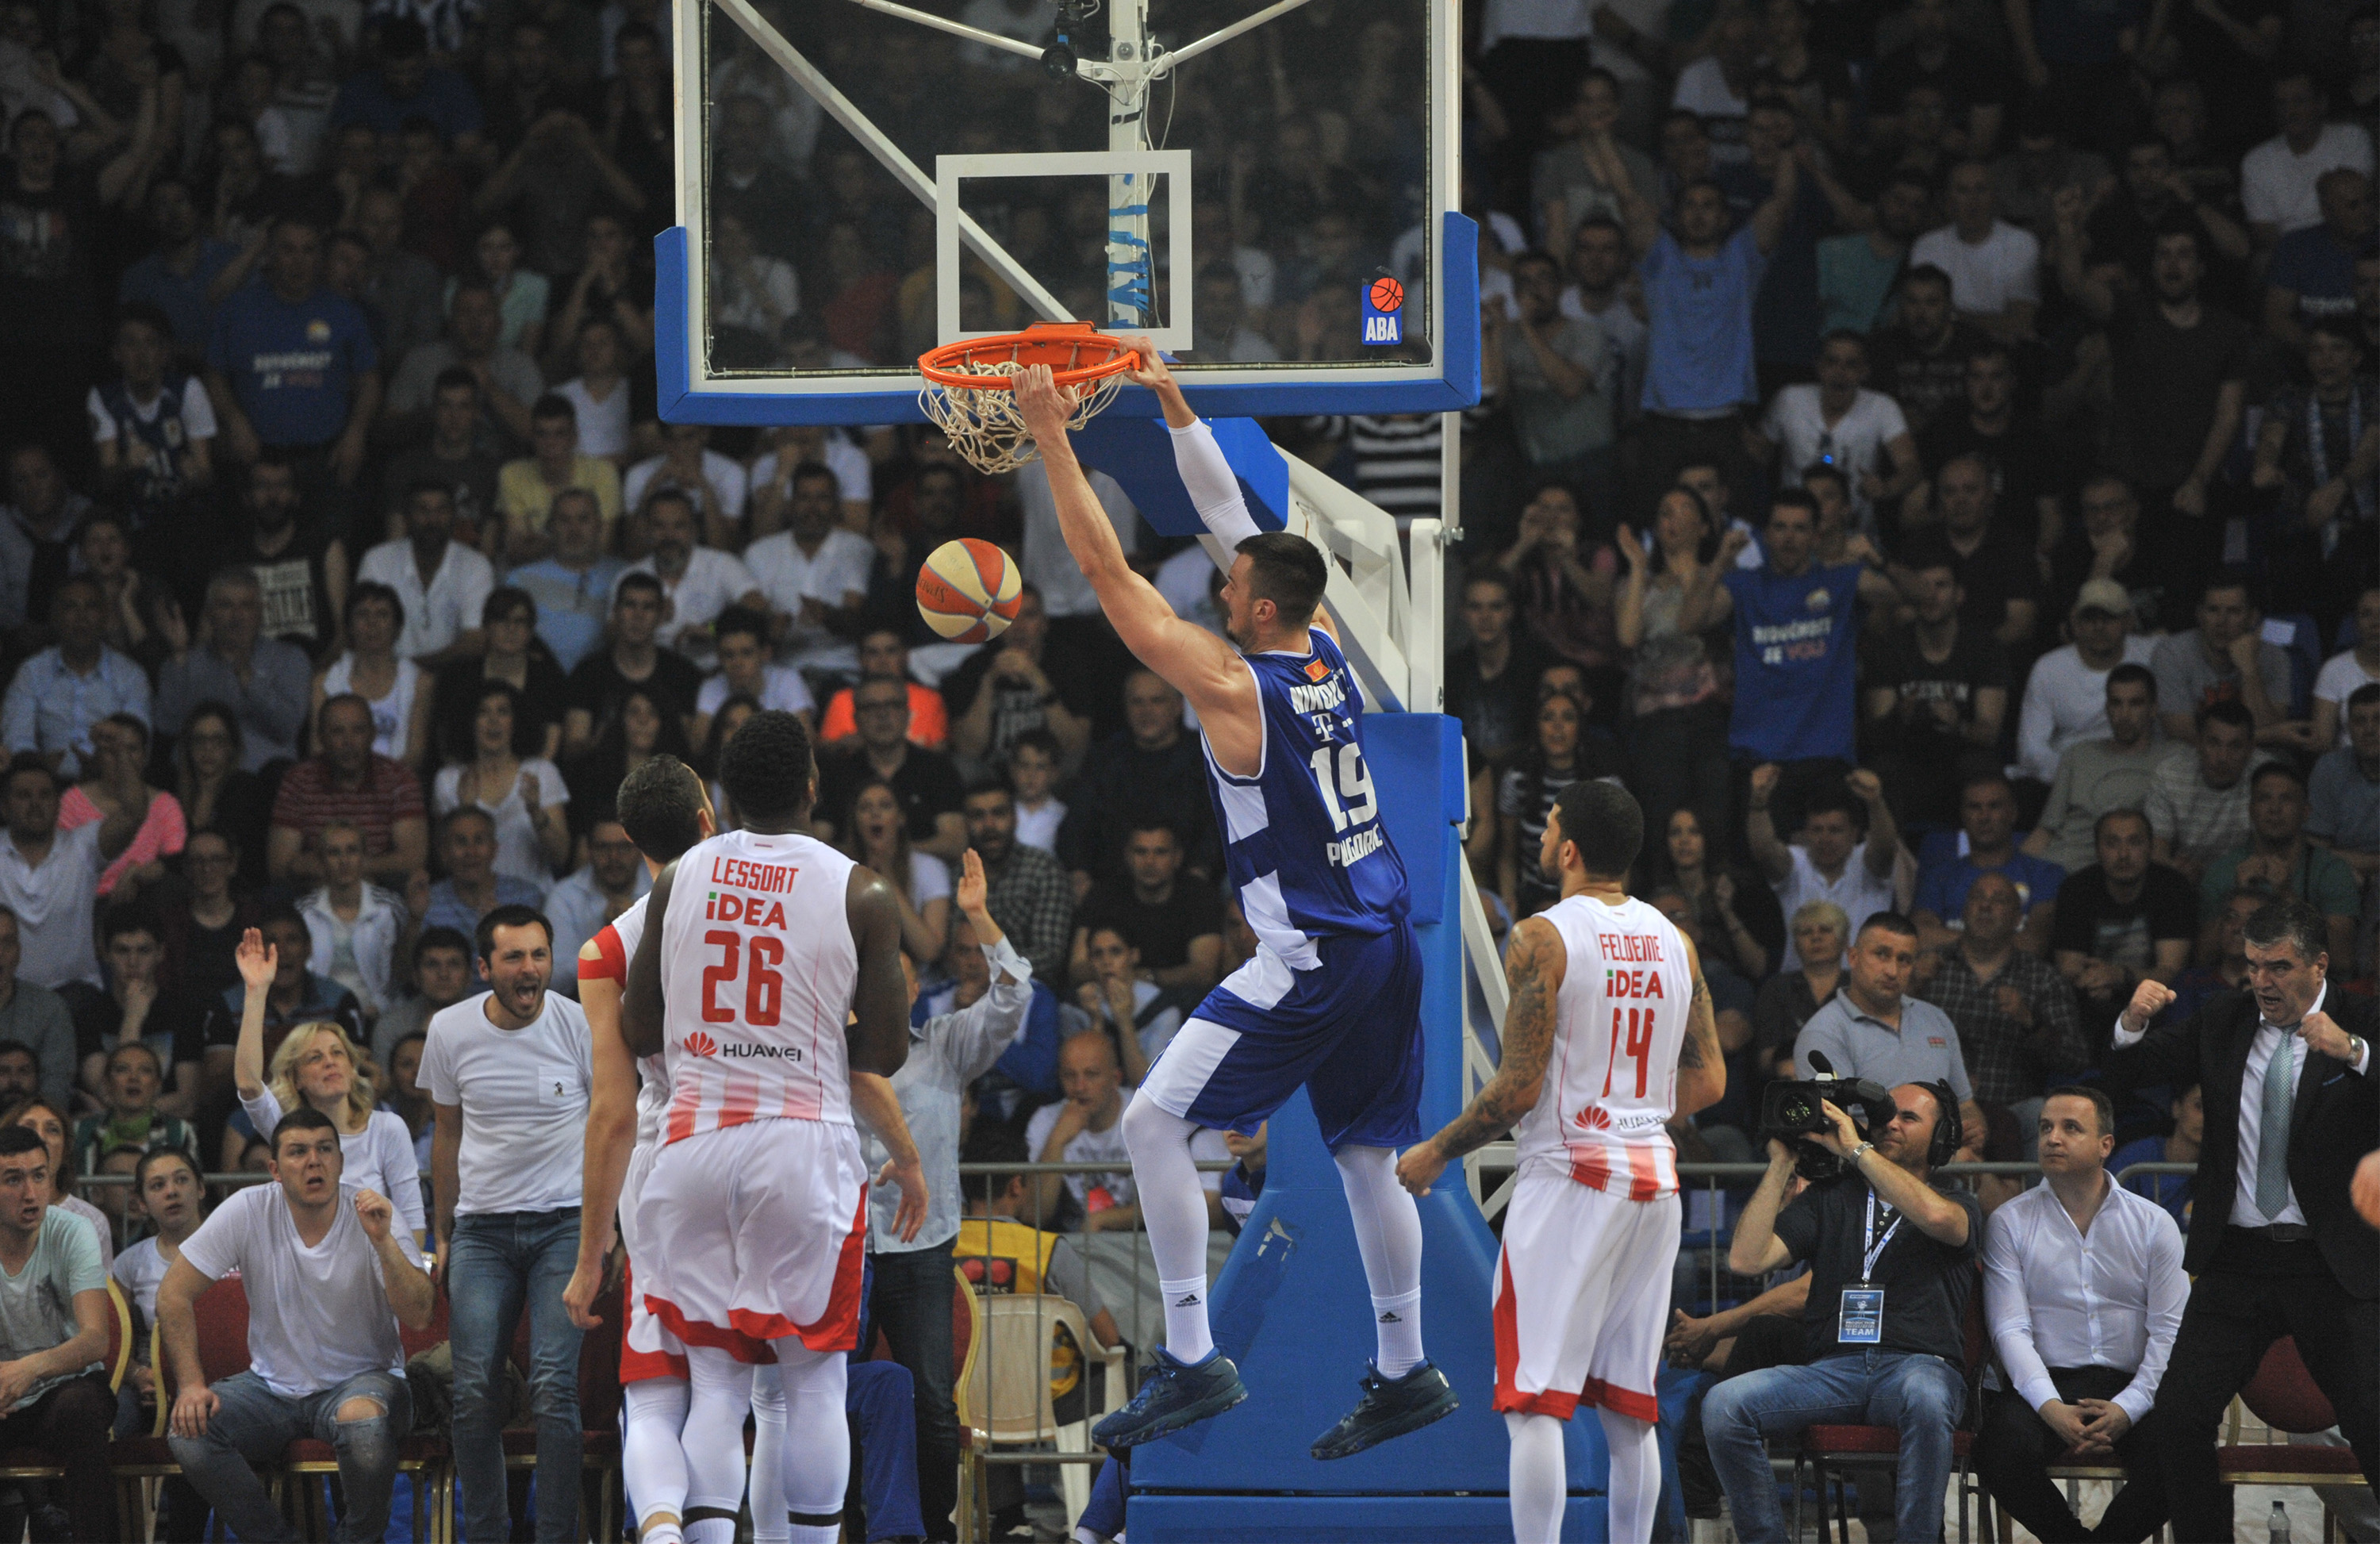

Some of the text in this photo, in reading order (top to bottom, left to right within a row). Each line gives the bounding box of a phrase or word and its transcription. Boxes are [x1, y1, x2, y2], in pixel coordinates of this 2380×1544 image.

[1365, 317, 1399, 341] ABA
[1310, 742, 1378, 833] 19
[712, 856, 800, 893] LESSORT
[702, 929, 785, 1027] 26
[724, 1043, 801, 1062] HUAWEI
[1602, 1007, 1655, 1099] 14
